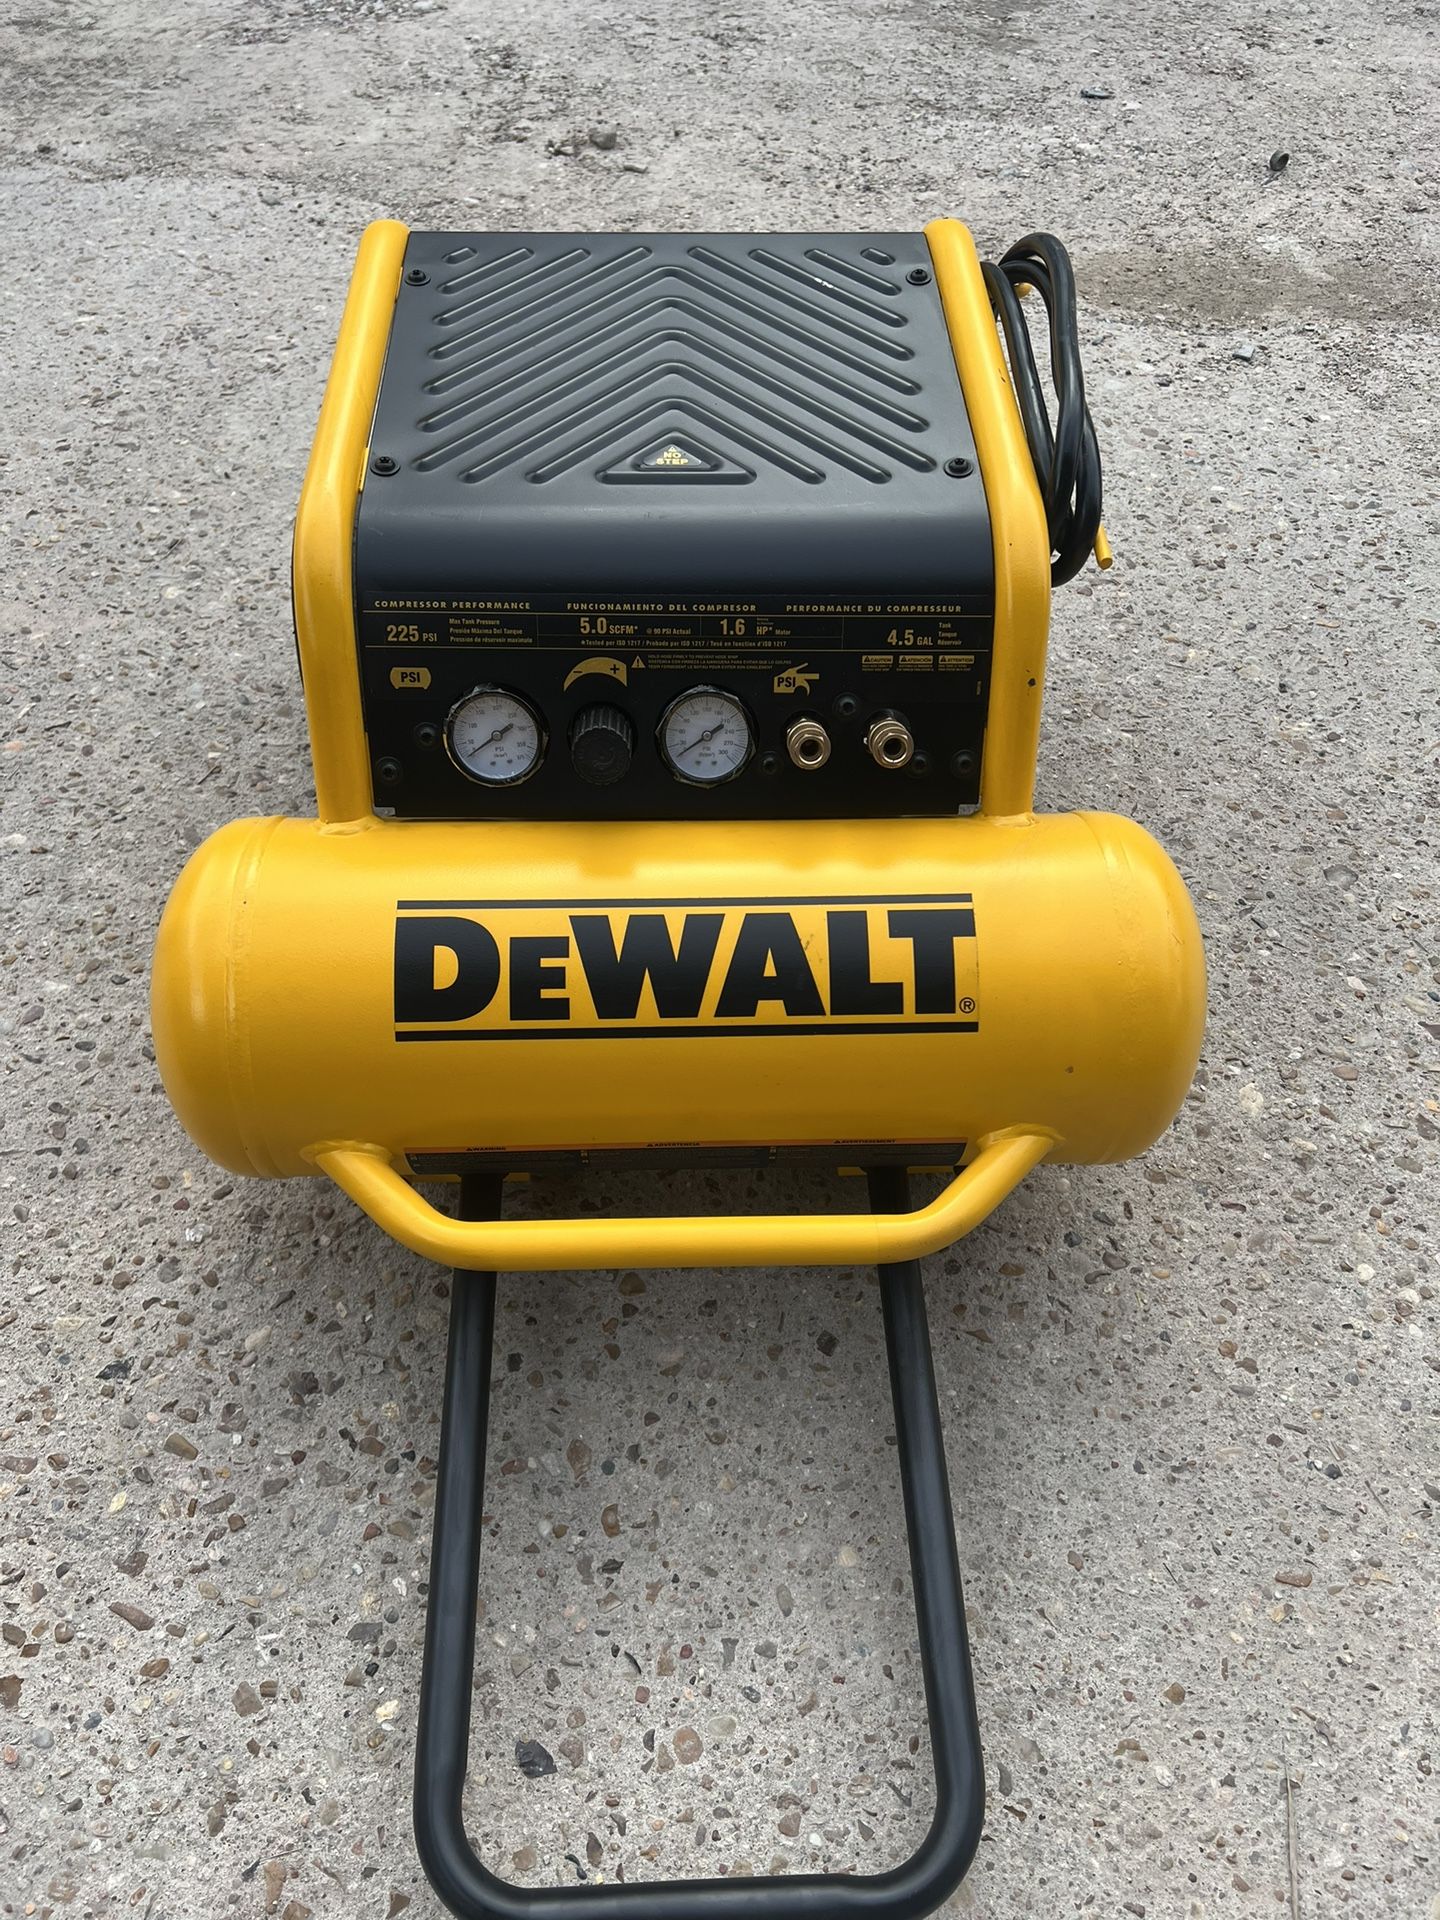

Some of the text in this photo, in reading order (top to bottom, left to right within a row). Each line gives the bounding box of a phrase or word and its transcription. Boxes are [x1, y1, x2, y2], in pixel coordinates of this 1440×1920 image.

[374, 600, 530, 610] COMPRESSOR PERFORMANCE
[567, 603, 756, 612] FUNCIONAMIENTO DEL COMPRESOR
[887, 605, 962, 613] COMPRESSEUR
[580, 617, 607, 634] 5.0
[720, 618, 746, 635] 1.6
[386, 625, 437, 642] 225 PSI
[888, 629, 933, 645] 4.5 GAL
[401, 672, 420, 683] PSI
[777, 676, 796, 687] PSI
